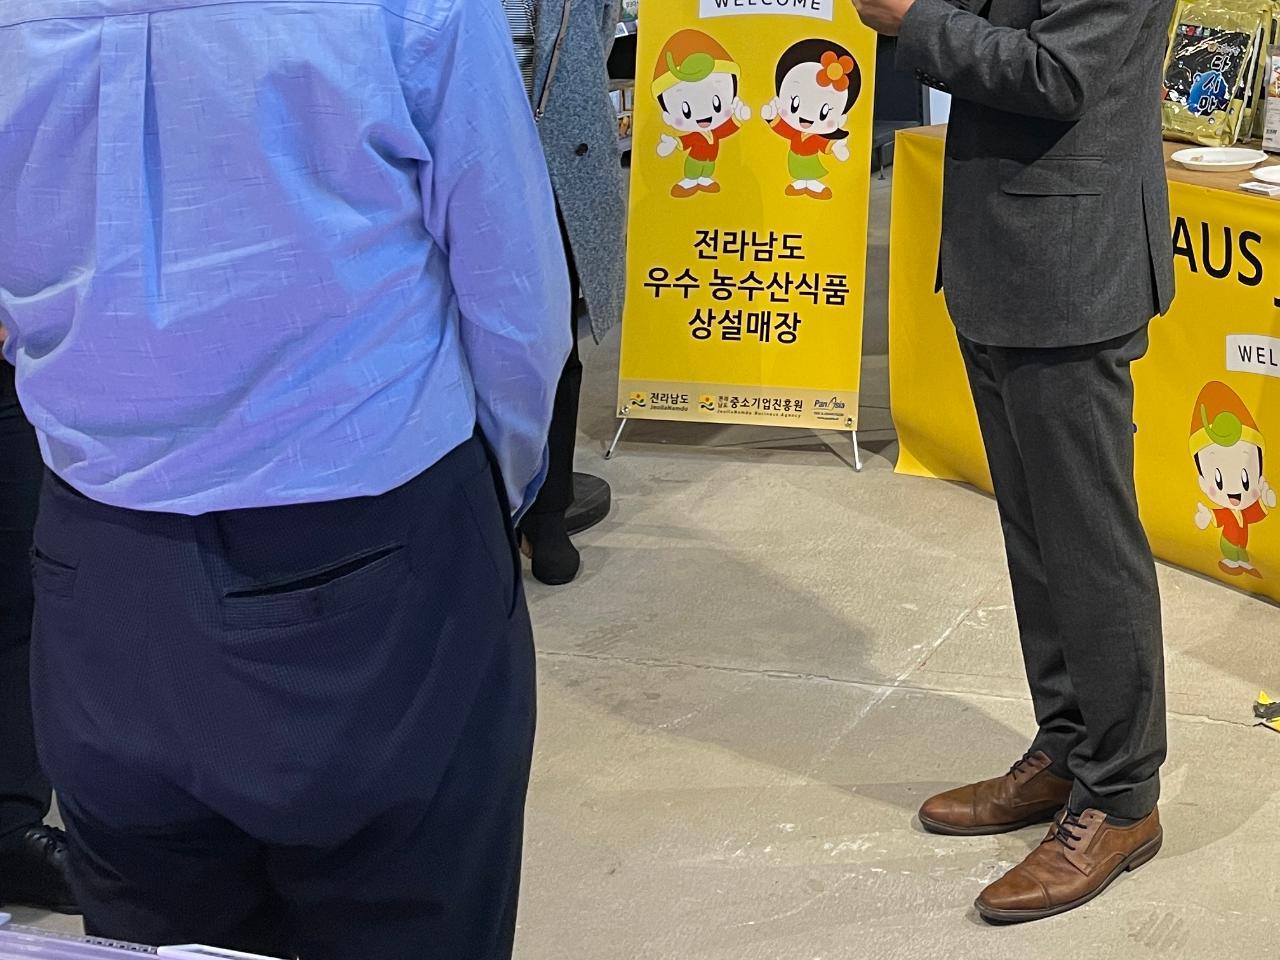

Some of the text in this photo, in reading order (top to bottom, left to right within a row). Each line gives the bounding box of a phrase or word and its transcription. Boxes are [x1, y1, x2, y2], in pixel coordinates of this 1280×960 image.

[693, 229, 806, 262] 전라남도
[1172, 216, 1263, 287] AUS
[643, 267, 850, 306] 우수 농수산식품
[688, 307, 802, 344] 상설매장
[650, 392, 689, 405] 전라남도
[729, 395, 804, 413] 중소기업진흥원
